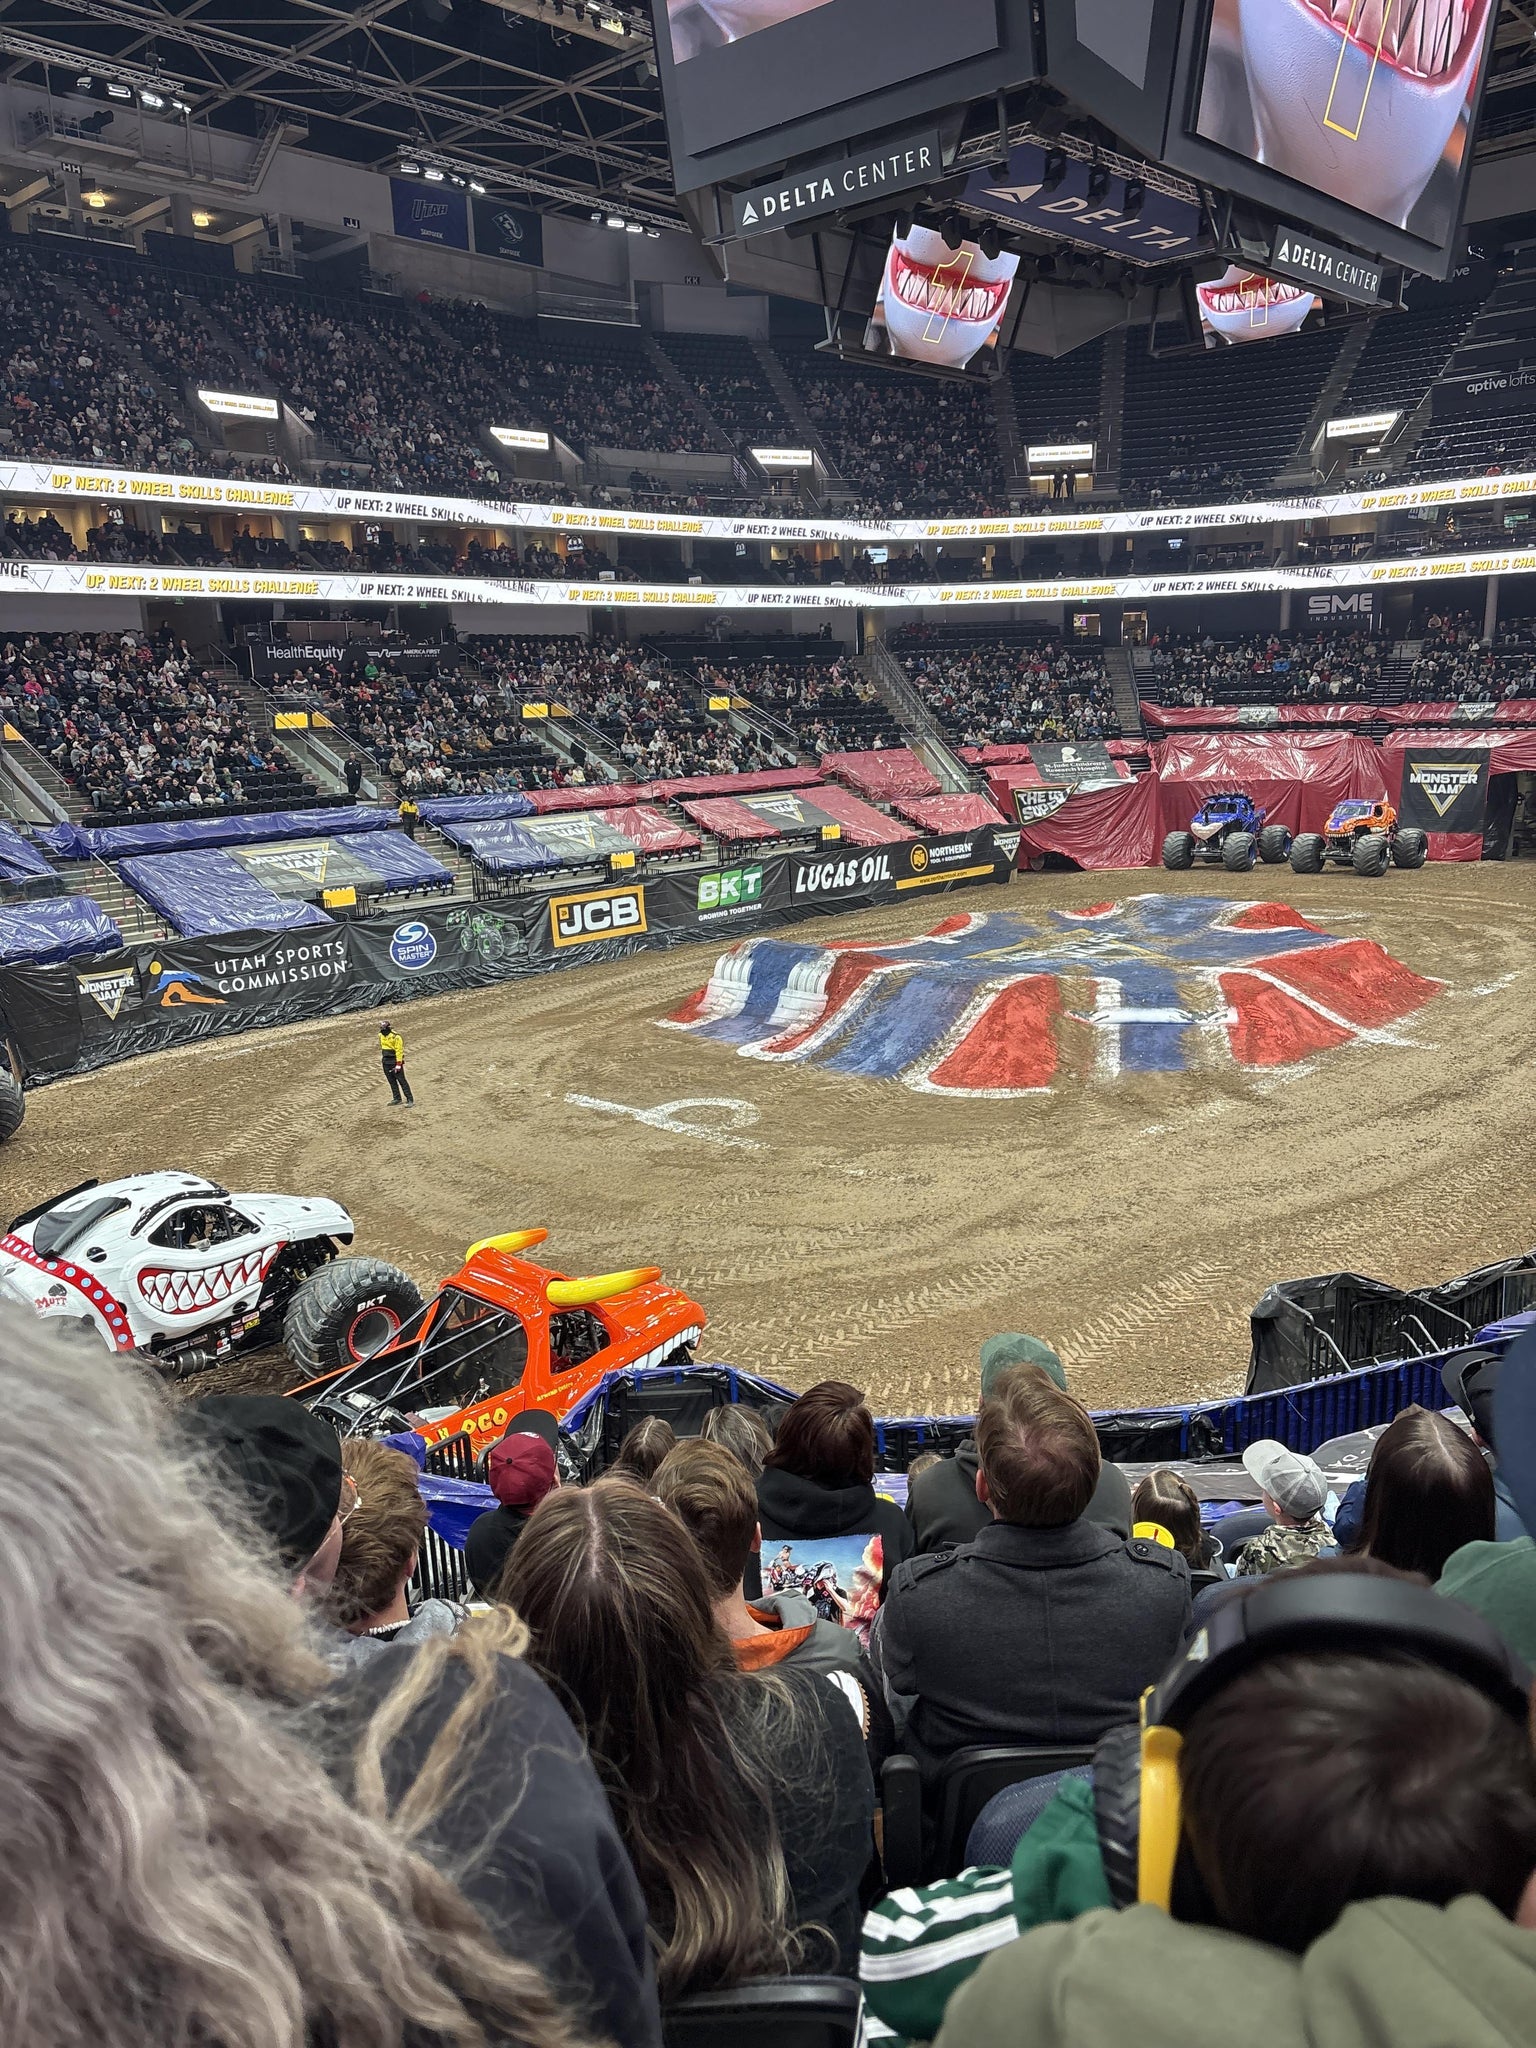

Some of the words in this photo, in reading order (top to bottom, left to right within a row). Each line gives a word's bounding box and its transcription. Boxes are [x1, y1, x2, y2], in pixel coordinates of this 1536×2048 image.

[762, 176, 835, 218] DELTA
[842, 145, 932, 193] CENTER
[411, 199, 449, 221] UTAH
[1036, 195, 1193, 253] DELTA
[1291, 243, 1333, 277] DELTA
[1335, 258, 1378, 293] CENTER
[921, 251, 974, 344] 1
[1466, 377, 1507, 395] aptive
[1508, 371, 1536, 388] lofts
[52, 474, 72, 489] UP
[76, 476, 114, 493] NEXT:
[118, 479, 126, 493] 2
[131, 481, 175, 497] WHEEL
[179, 484, 222, 501] SKILLS
[226, 488, 294, 506] CHALLENGE
[1361, 498, 1377, 509] UP
[1378, 494, 1408, 507] NEXT:
[1410, 493, 1417, 504] 2
[1420, 489, 1456, 503] WHEEL
[1459, 483, 1499, 498] SKILLS
[337, 497, 352, 509] UP
[354, 497, 384, 512] NEXT:
[385, 501, 392, 513] 2
[395, 503, 428, 518] WHEEL
[552, 512, 563, 524] UP
[565, 514, 590, 526] NEXT:
[591, 516, 597, 527] 2
[599, 516, 626, 529] WHEEL
[628, 518, 654, 531] SKILLS
[657, 520, 703, 533] CHALLENGE
[927, 525, 940, 535] UP
[941, 524, 969, 535] NEXT:
[970, 524, 976, 535] 2
[979, 523, 1011, 535] WHEEL
[1013, 521, 1046, 533] SKILLS
[1049, 519, 1103, 531] CHALLENGE
[1140, 516, 1154, 527] UP
[1156, 515, 1183, 525] NEXT:
[1185, 514, 1192, 525] 2
[1194, 513, 1226, 524] WHEEL
[733, 523, 745, 534] UP
[747, 524, 770, 535] NEXT:
[772, 525, 777, 536] 2
[779, 526, 808, 538] WHEEL
[1371, 569, 1386, 580] UP
[1388, 566, 1418, 579] NEXT:
[1419, 566, 1427, 577] 2
[1430, 562, 1467, 576] WHEEL
[1469, 558, 1509, 573] SKILLS
[86, 574, 105, 589] UP
[109, 574, 147, 590] NEXT:
[149, 576, 159, 591] 2
[161, 577, 205, 592] WHEEL
[208, 578, 249, 593] SKILLS
[253, 580, 319, 595] CHALLENGE
[360, 583, 374, 595] UP
[376, 583, 405, 597] NEXT:
[407, 585, 414, 597] 2
[416, 586, 449, 600] WHEEL
[940, 590, 954, 601] UP
[955, 590, 982, 601] NEXT:
[982, 590, 990, 600] 2
[992, 588, 1022, 600] WHEEL
[1025, 587, 1058, 599] SKILLS
[1061, 584, 1116, 597] CHALLENGE
[1152, 583, 1166, 592] UP
[1168, 582, 1195, 592] NEXT:
[1197, 581, 1204, 591] 2
[1205, 581, 1238, 591] WHEEL
[568, 589, 580, 601] UP
[582, 590, 606, 602] NEXT:
[606, 591, 612, 602] 2
[614, 590, 640, 603] WHEEL
[643, 591, 669, 603] SKILLS
[671, 592, 716, 604] CHALLENGE
[747, 593, 759, 604] UP
[761, 593, 784, 604] NEXT:
[785, 594, 791, 604] 2
[793, 595, 822, 606] WHEEL
[1308, 593, 1373, 615] SME
[266, 645, 344, 661] HealthEquity
[1409, 773, 1477, 785] MONSTER
[1427, 783, 1459, 795] JAM
[747, 799, 803, 810] MONSTER
[1018, 791, 1046, 806] THE
[770, 805, 797, 814] JAM
[528, 820, 599, 834] MONSTER
[245, 849, 340, 865] MONSTER
[929, 842, 972, 858] NORTHERN
[945, 852, 971, 862] EQUIPMENT
[284, 858, 325, 871] JAM
[795, 858, 858, 893] LUCAS
[862, 854, 891, 884] OIL
[698, 872, 759, 903] BKT
[560, 896, 640, 936] JCB
[698, 911, 728, 922] GROWING
[729, 903, 760, 917] TOGETHER
[397, 942, 429, 955] SPIN
[398, 951, 430, 962] MASTER
[214, 955, 266, 975] UTAH
[275, 941, 345, 965] SPORTS
[78, 976, 135, 995] MONSTER
[218, 962, 348, 995] COMMISSION
[98, 989, 122, 1001] JAM
[357, 1295, 386, 1313] BKT
